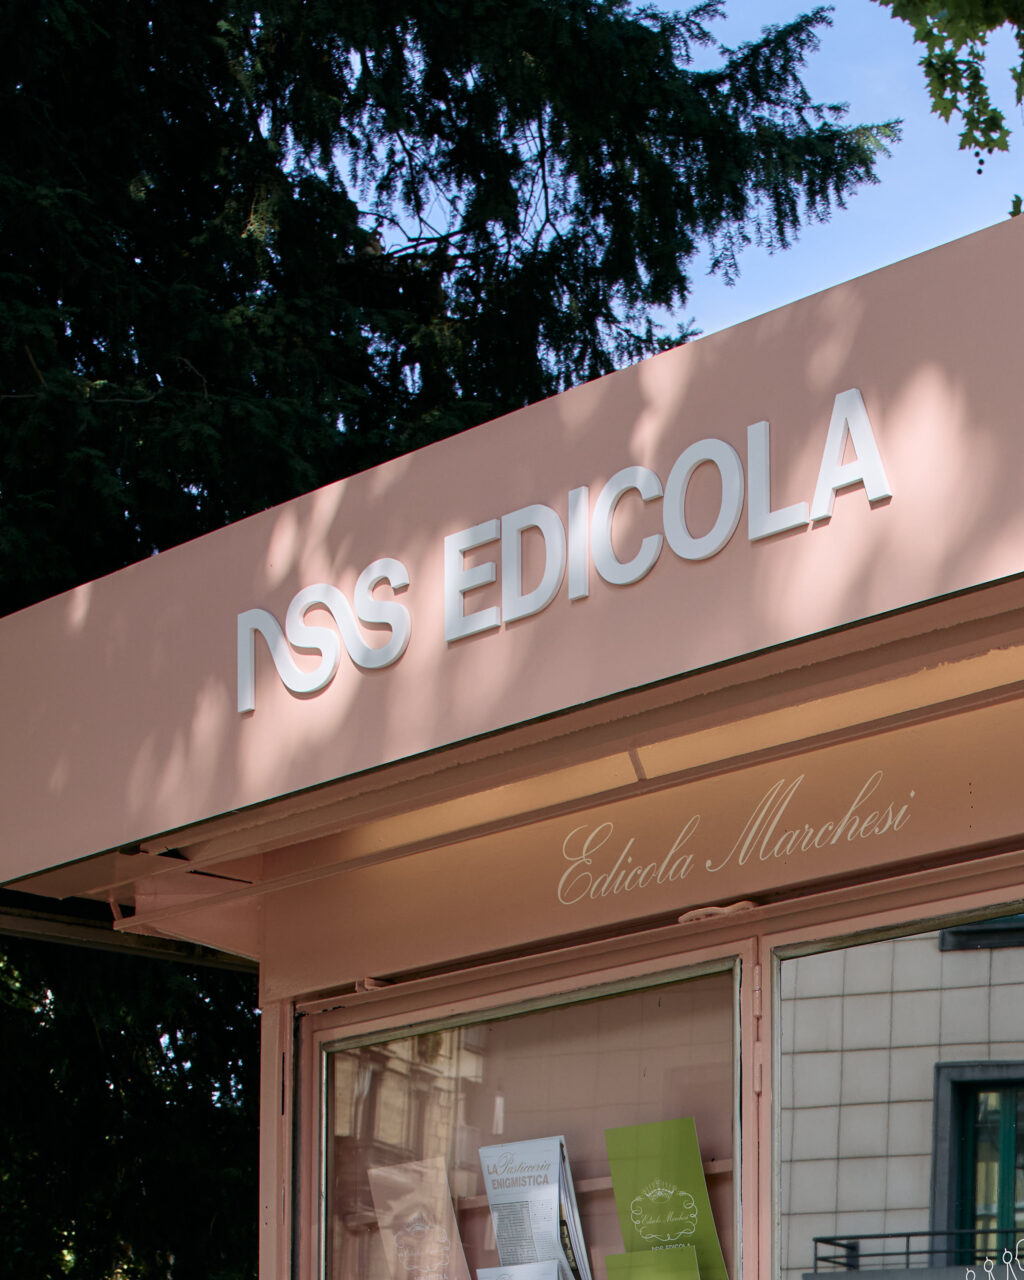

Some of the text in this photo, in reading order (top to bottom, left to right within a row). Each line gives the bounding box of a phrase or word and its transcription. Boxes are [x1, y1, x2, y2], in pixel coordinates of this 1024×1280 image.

[444, 388, 893, 642] EDICOLA
[556, 770, 917, 905] Edicola Marchesi
[487, 1164, 498, 1175] LA
[492, 1174, 550, 1190] ENIGMISTICA
